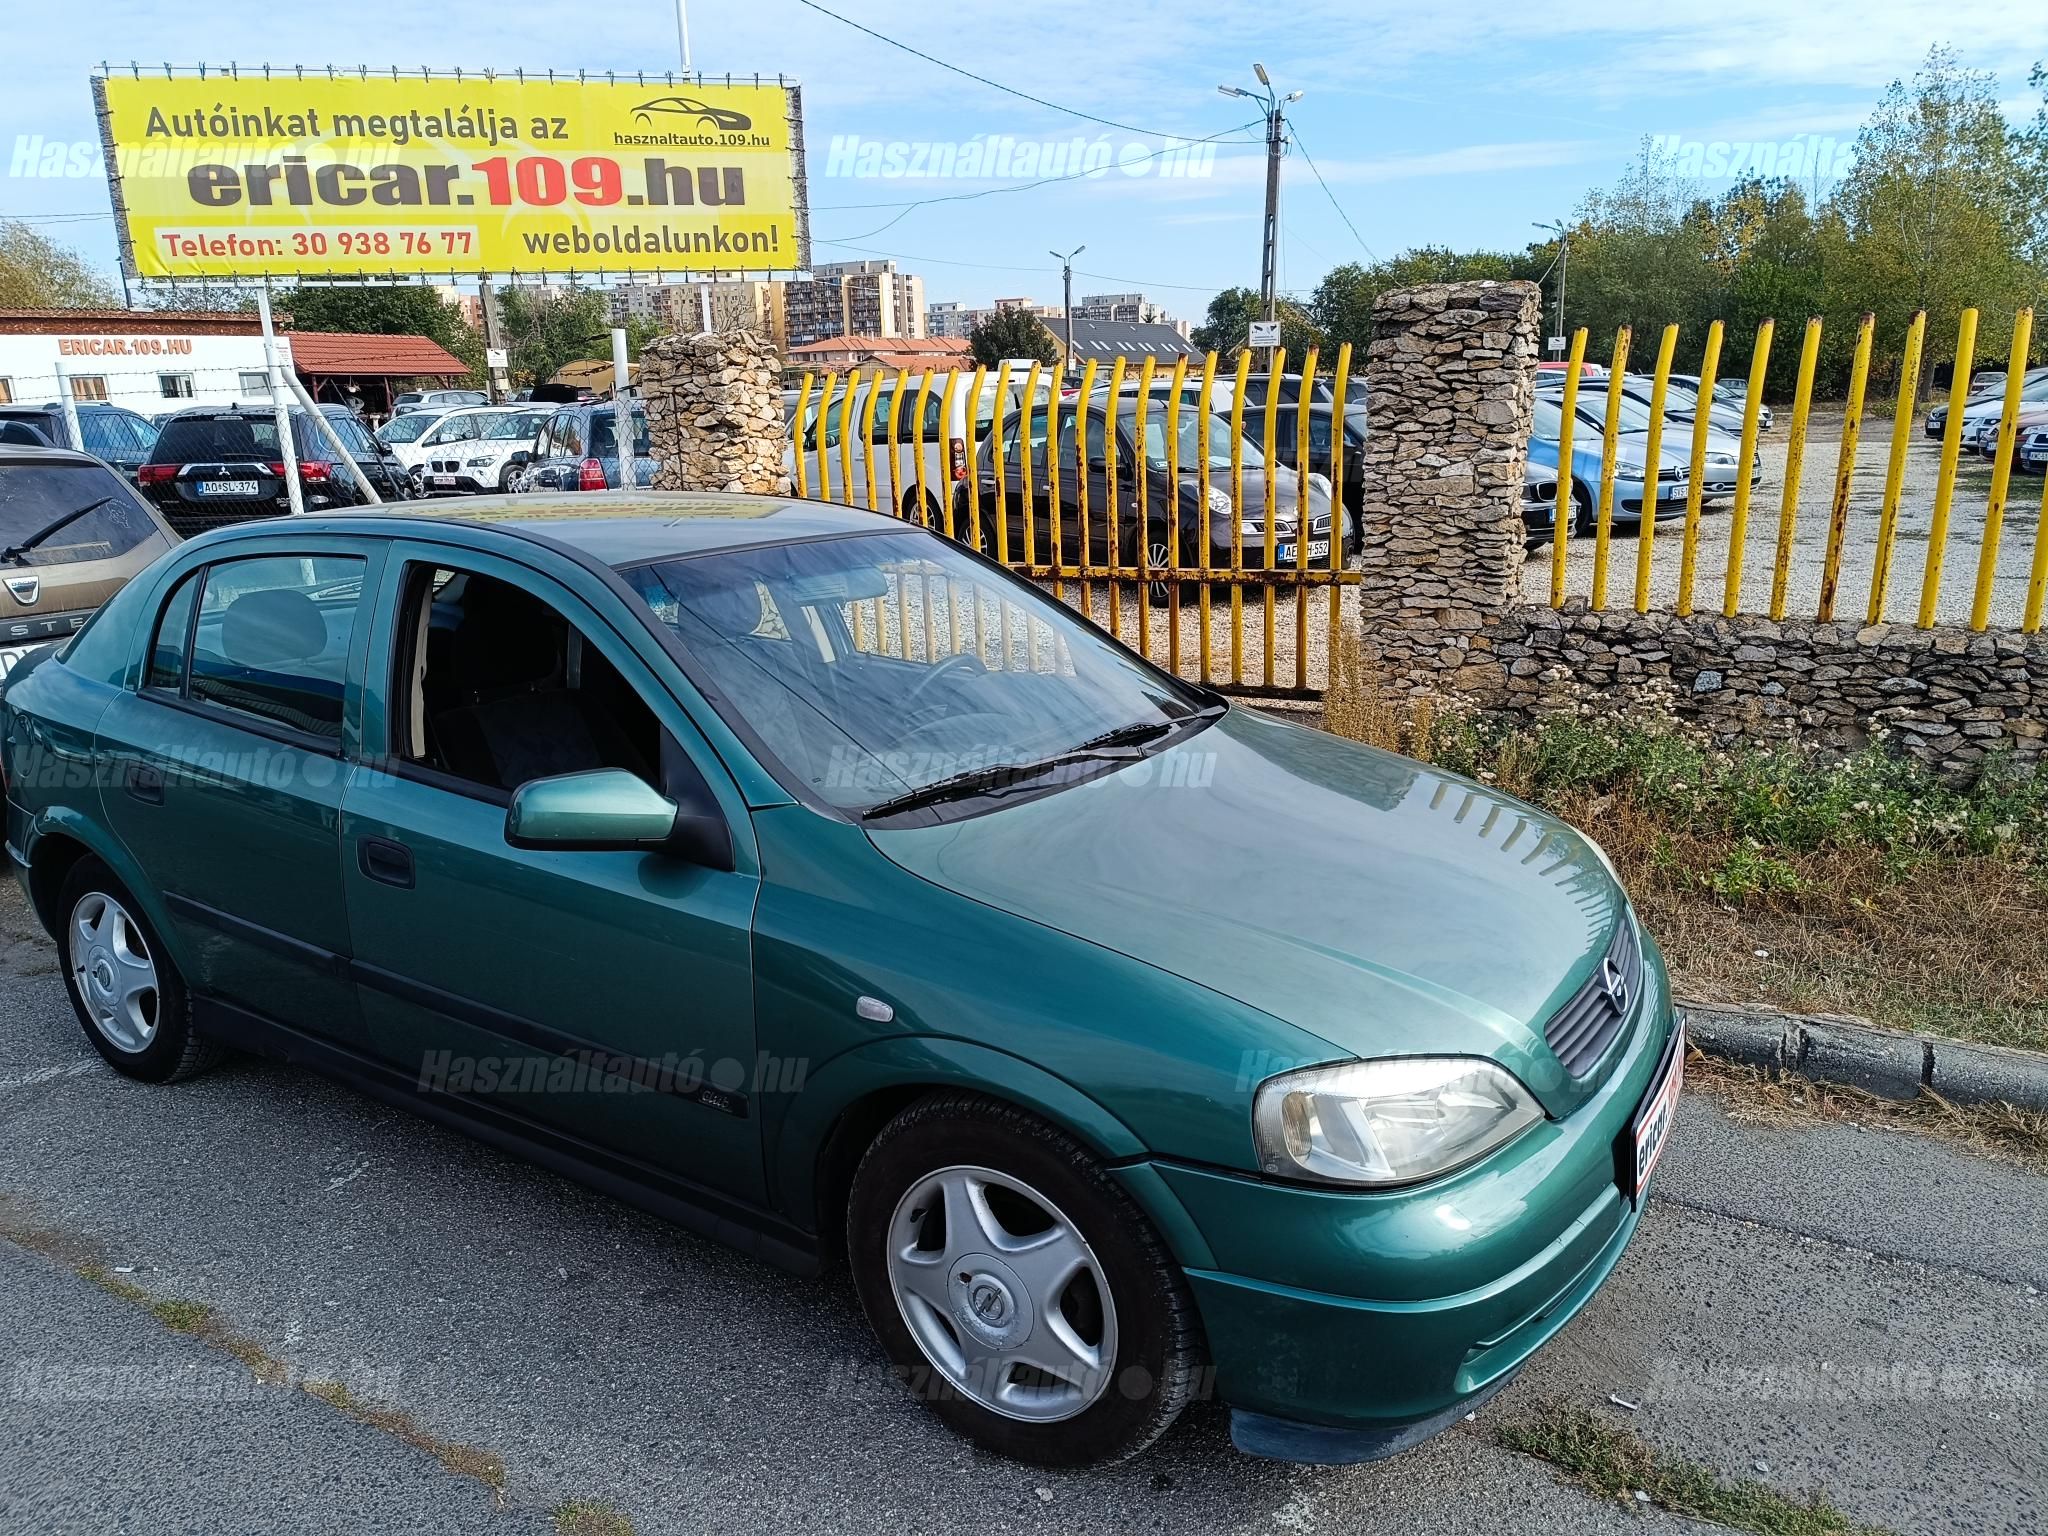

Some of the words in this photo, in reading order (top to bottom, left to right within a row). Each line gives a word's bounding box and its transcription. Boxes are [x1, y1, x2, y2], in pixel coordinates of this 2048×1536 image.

[146, 102, 320, 138] Autóinkat
[333, 104, 518, 146] megtalálja
[531, 115, 569, 139] az
[614, 132, 770, 146] hasznaltauto.109.hu
[187, 156, 745, 207] ericar.109.hu
[162, 233, 283, 257] Telefon:
[292, 233, 328, 255] 30
[337, 232, 390, 255] 938
[400, 232, 431, 255] 76
[440, 232, 471, 254] 77
[523, 225, 779, 254] weboldalunkon!
[58, 339, 193, 356] ERICAR.109.HU
